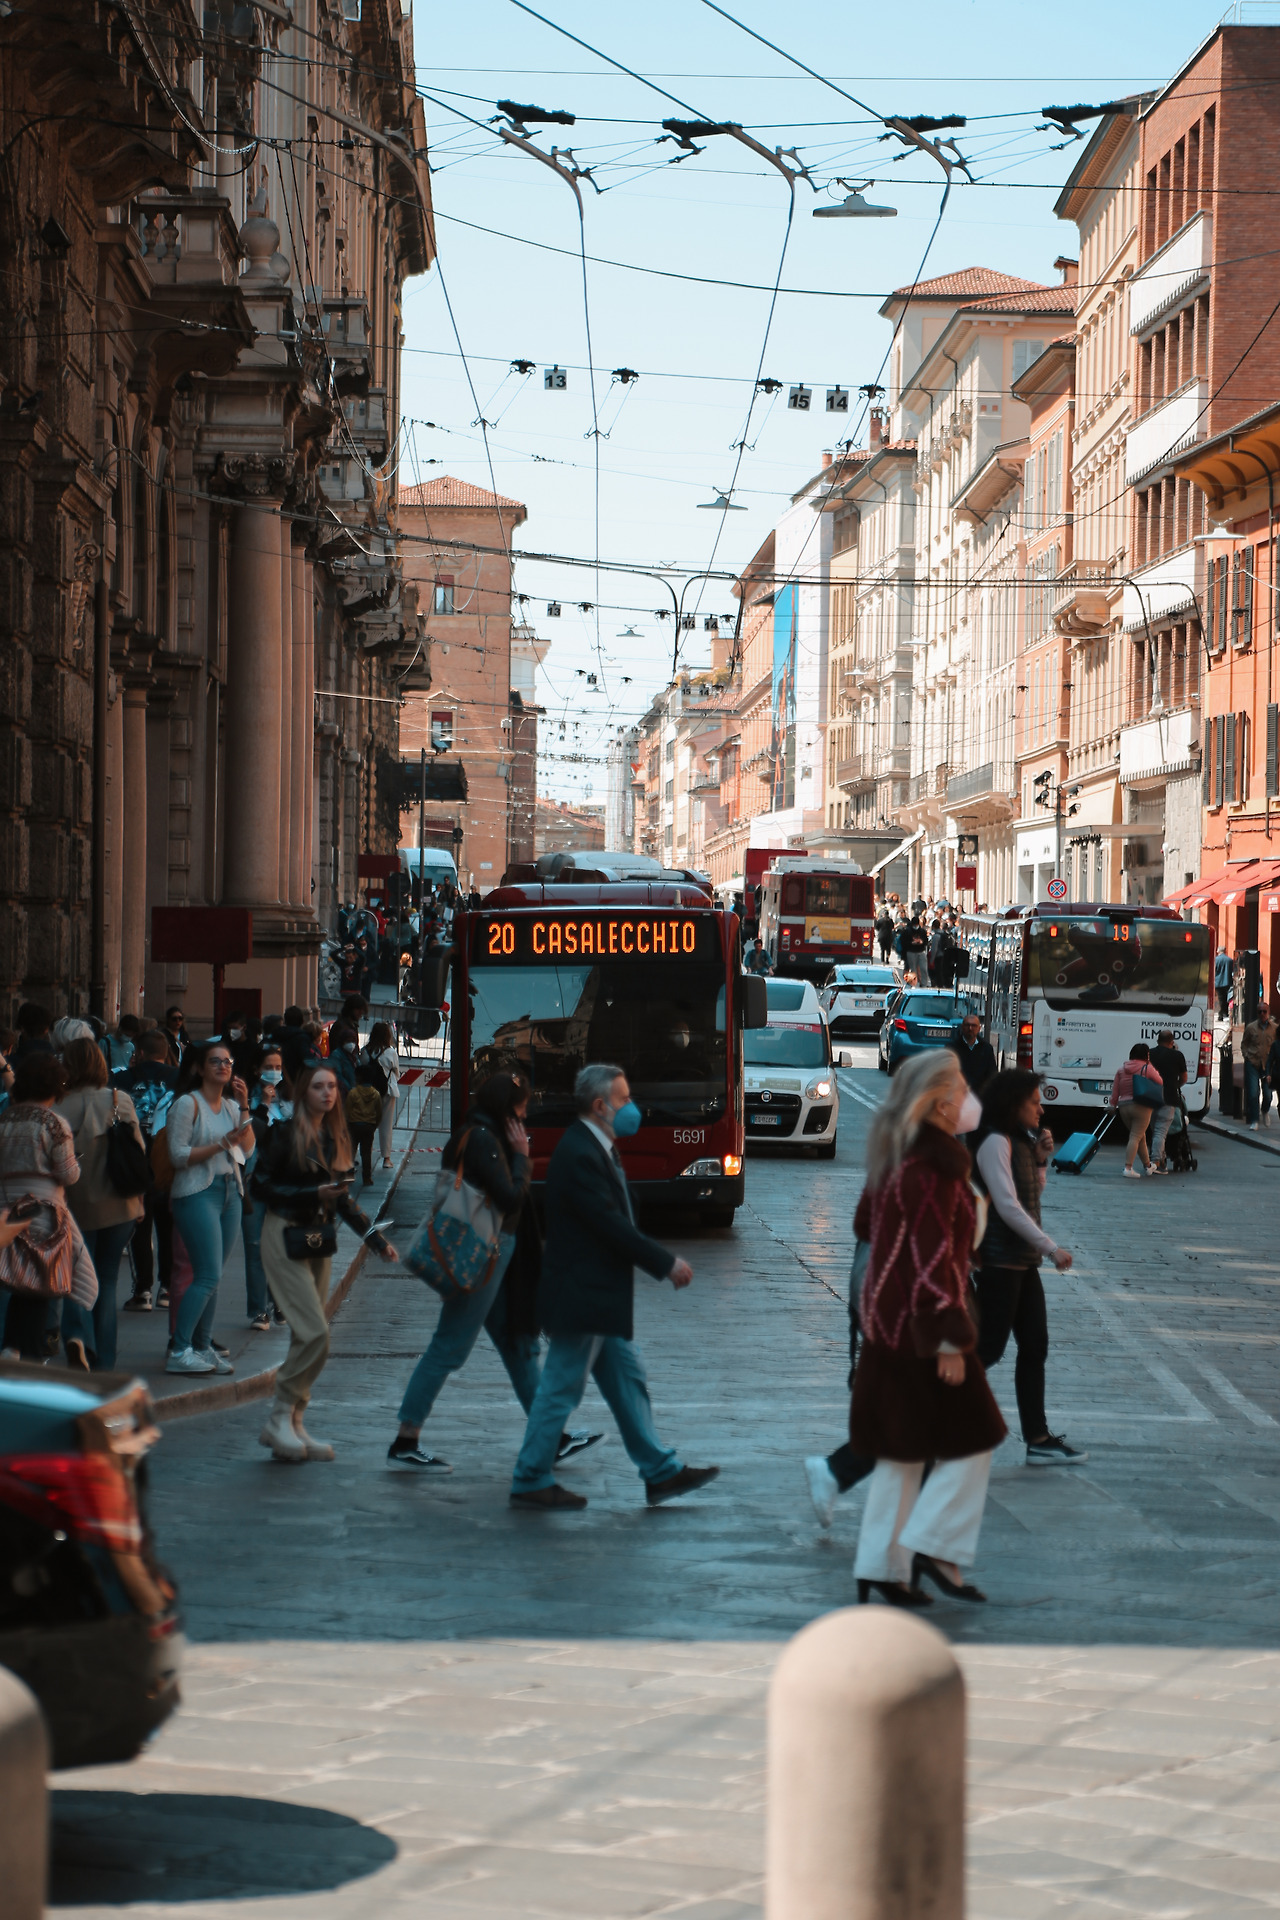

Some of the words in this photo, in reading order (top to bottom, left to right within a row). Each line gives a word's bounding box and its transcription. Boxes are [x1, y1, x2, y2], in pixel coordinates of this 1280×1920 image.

[545, 374, 566, 388] 13
[789, 394, 810, 410] 15
[827, 396, 848, 410] 14
[548, 607, 561, 616] 13
[705, 621, 718, 630] 14
[488, 923, 515, 954] 20
[533, 922, 695, 954] CASALECCHIO
[1113, 924, 1129, 941] 19
[1141, 1028, 1198, 1041] ILMDOL
[1047, 1089, 1056, 1097] 70
[673, 1129, 705, 1144] 5691
